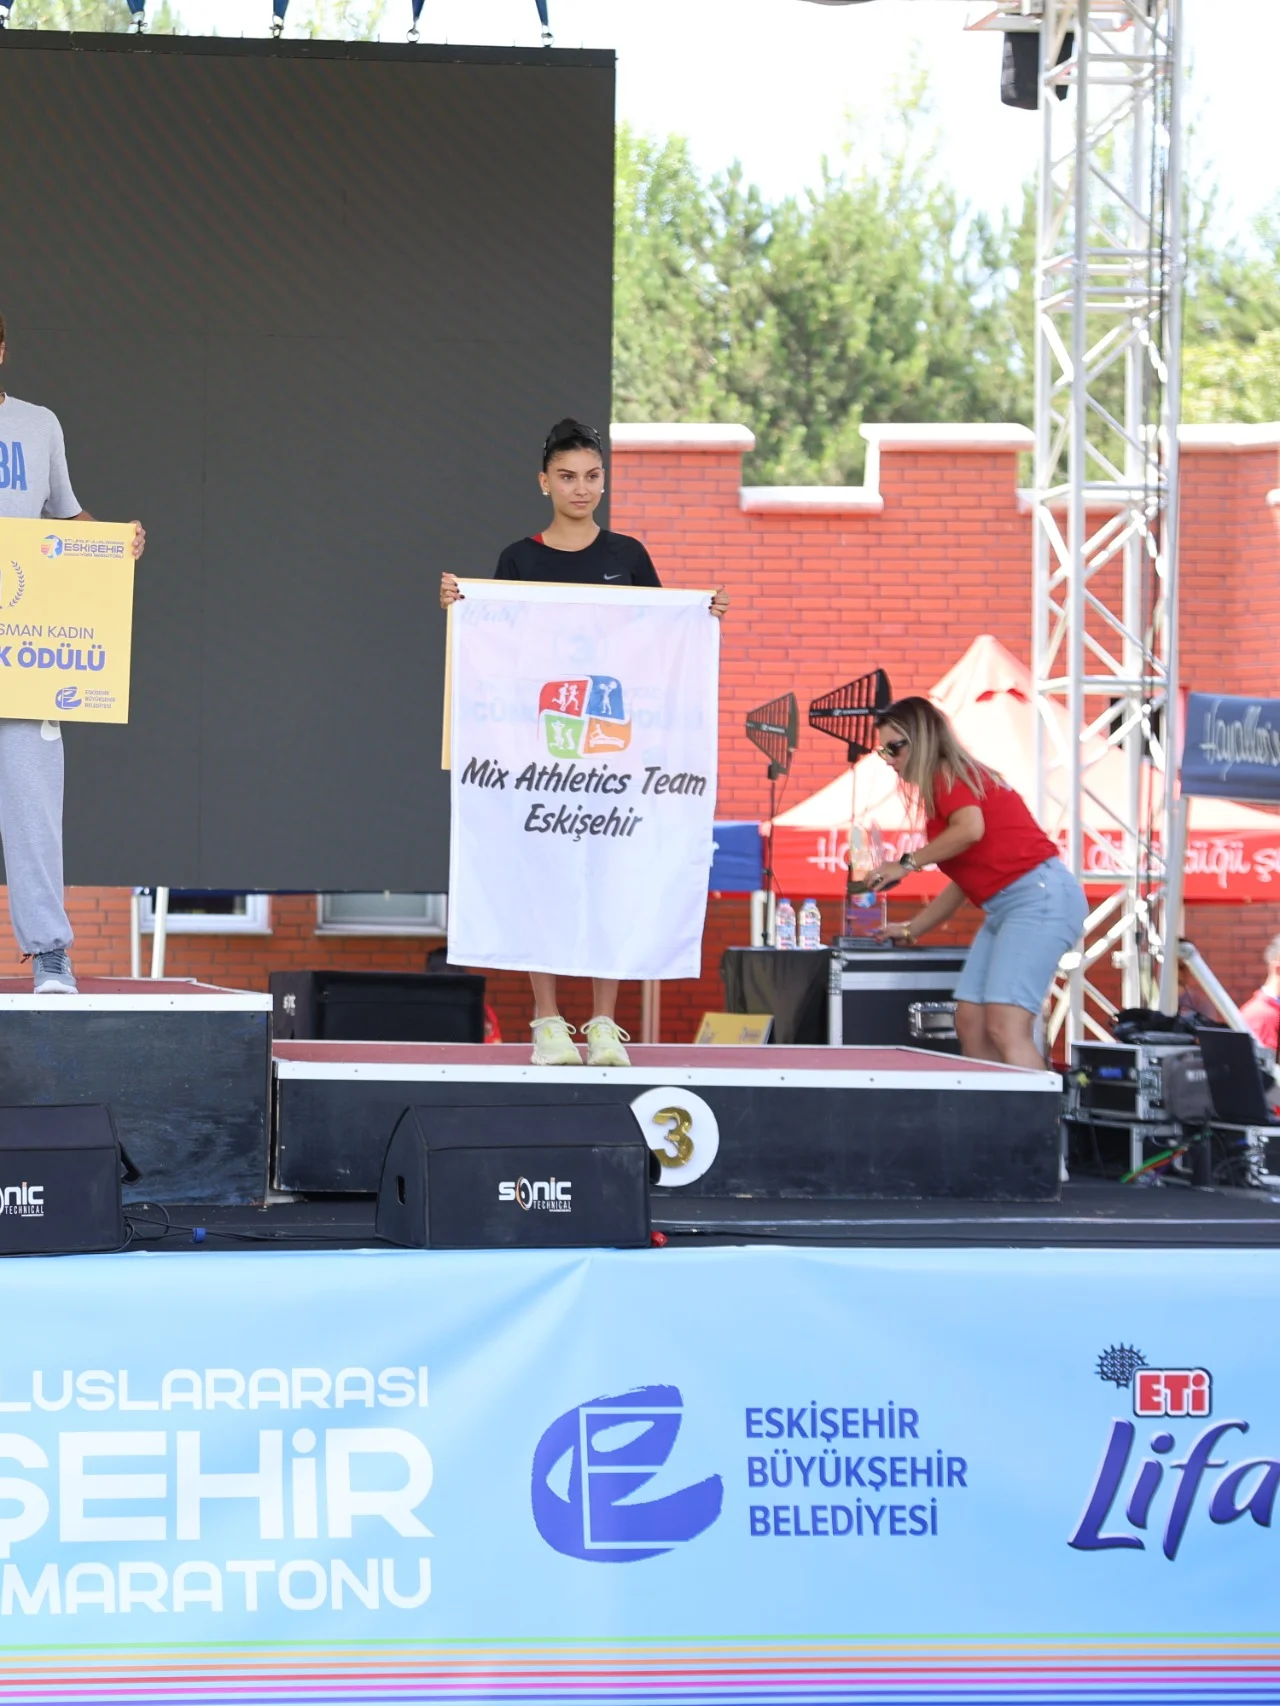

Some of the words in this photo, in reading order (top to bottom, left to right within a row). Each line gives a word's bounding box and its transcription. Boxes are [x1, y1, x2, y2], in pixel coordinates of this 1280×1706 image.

[47, 624, 95, 640] KADIN
[17, 639, 106, 672] ÖDÜLÜ
[460, 756, 510, 790] Mix
[514, 761, 632, 796] Athletics
[640, 766, 707, 797] Team
[523, 803, 644, 842] Eskişehir
[651, 1106, 695, 1168] 3
[4, 1204, 44, 1215] TECHNICAL
[532, 1200, 571, 1210] TECHNICAL
[744, 1400, 920, 1443] ESKİŞEHİR
[747, 1448, 968, 1492] BÜYÜKŞEHİR
[748, 1497, 939, 1537] BELEDİYESİ
[0, 1557, 432, 1616] MARATONU
